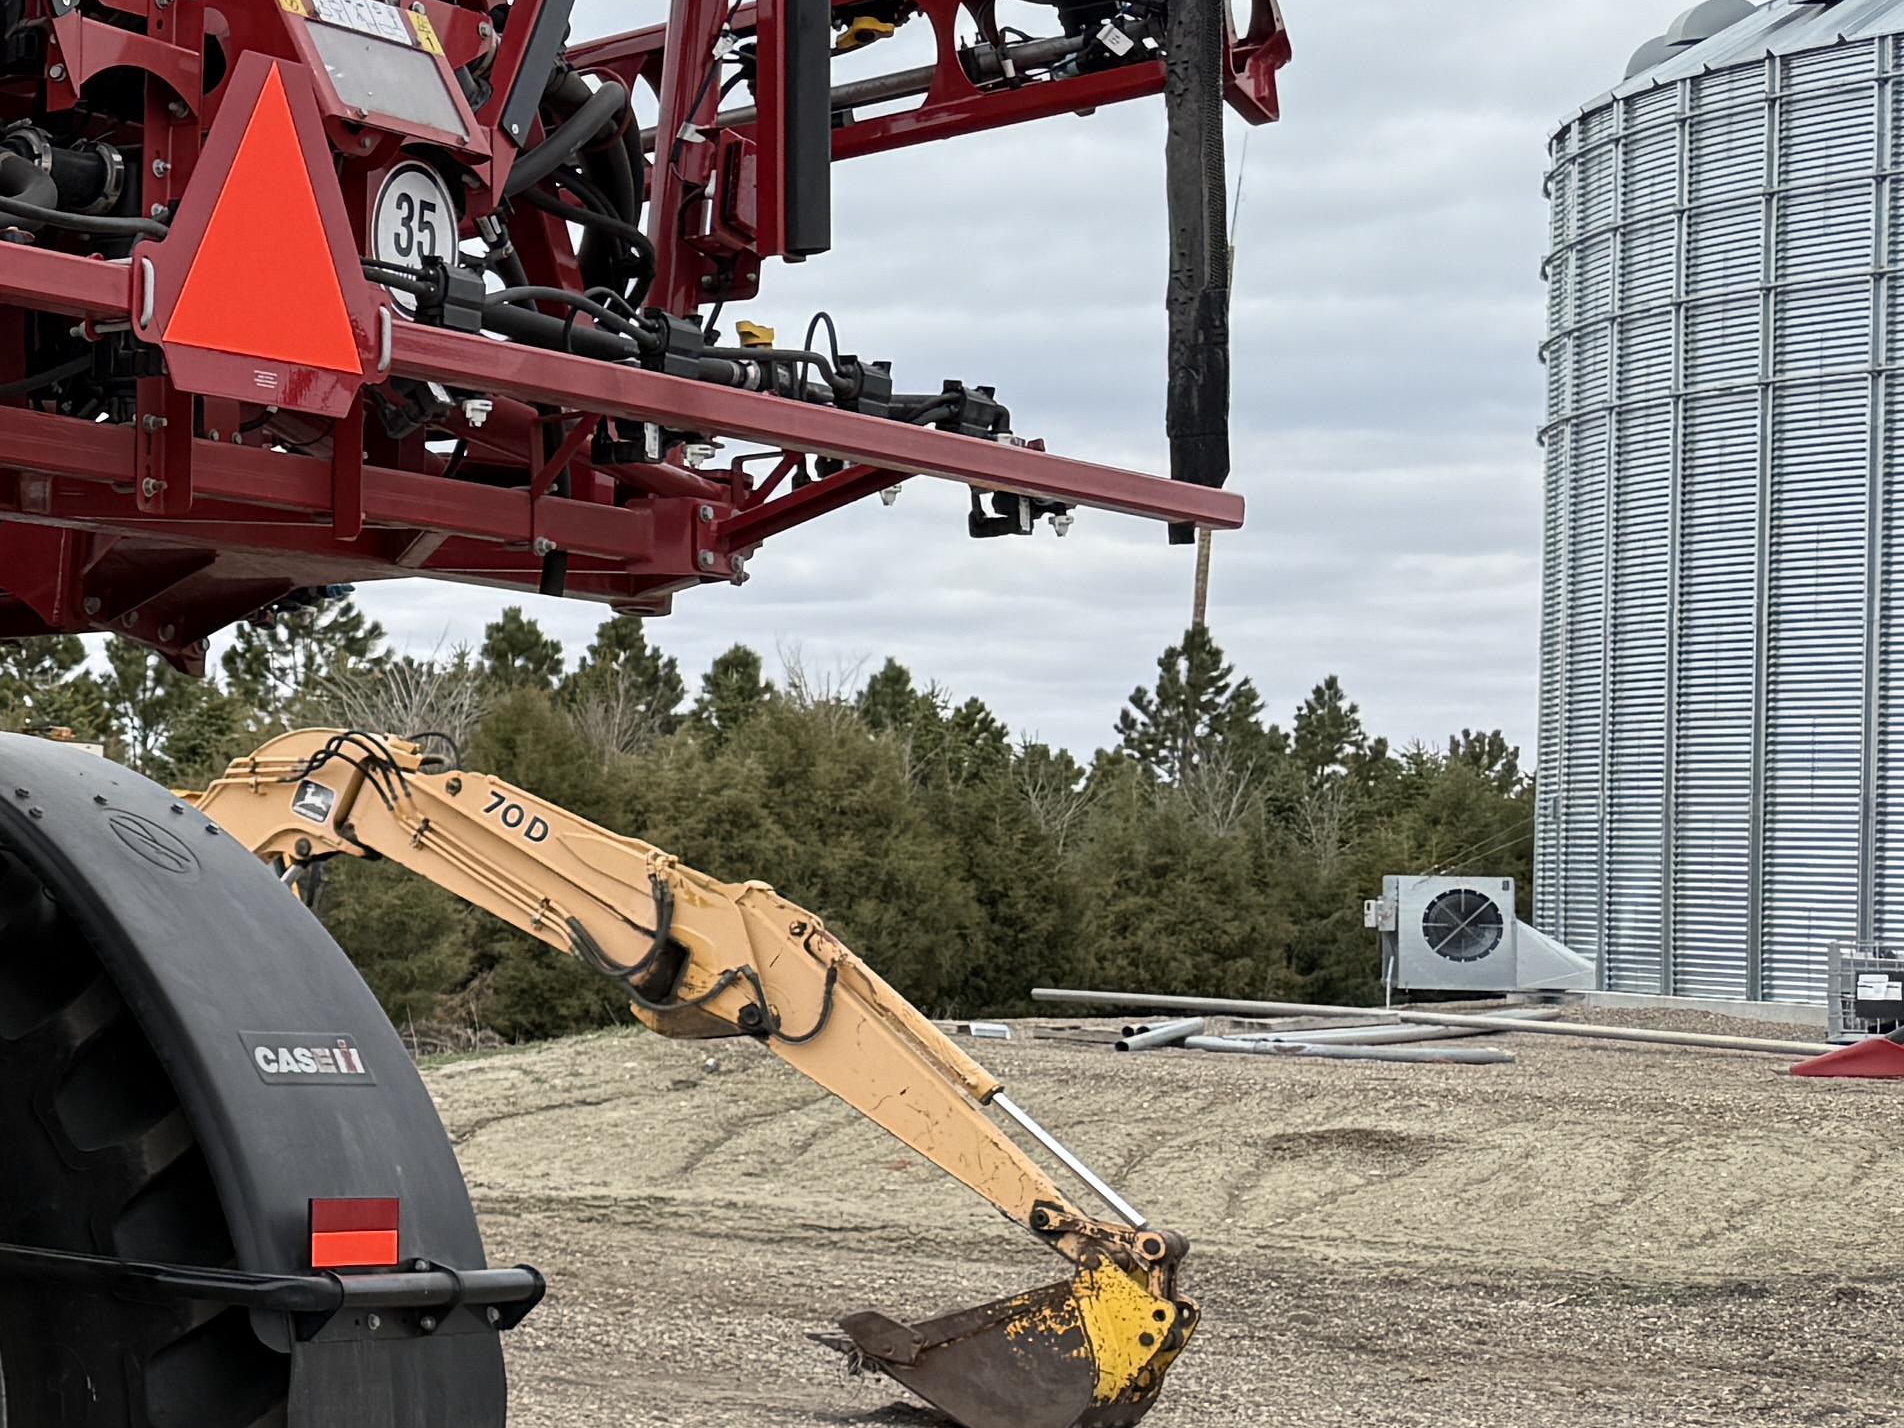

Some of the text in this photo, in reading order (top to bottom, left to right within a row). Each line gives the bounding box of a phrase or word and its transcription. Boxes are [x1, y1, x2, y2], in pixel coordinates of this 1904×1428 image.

[393, 192, 437, 259] 35
[482, 789, 550, 844] 70D
[254, 1045, 334, 1075] CASE
